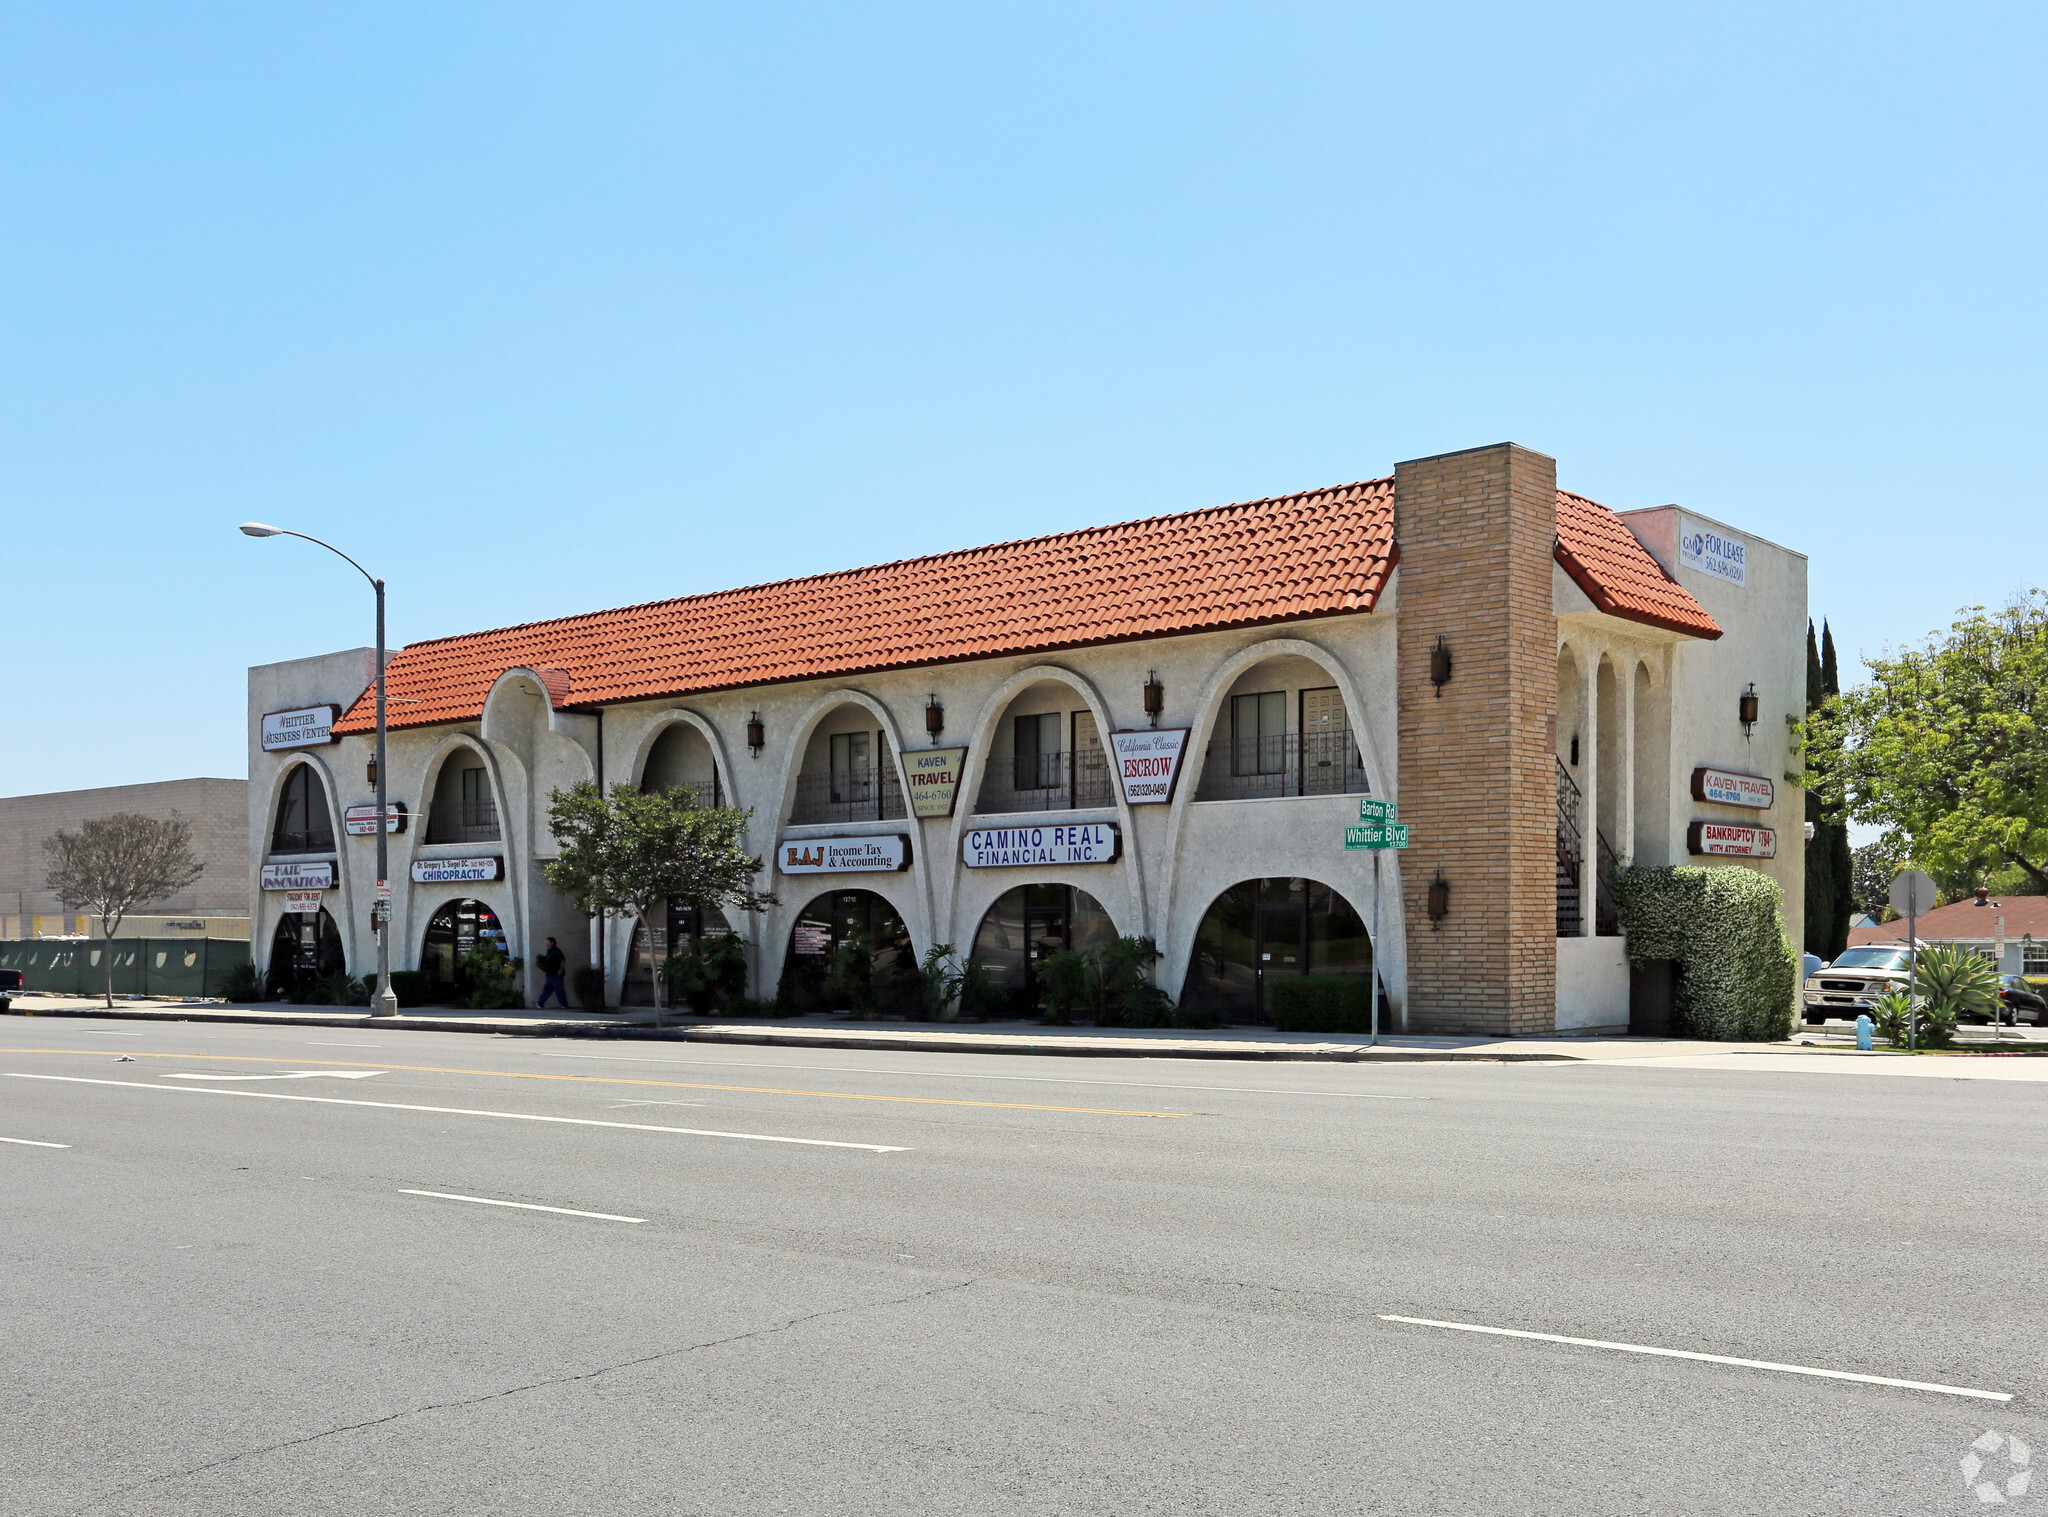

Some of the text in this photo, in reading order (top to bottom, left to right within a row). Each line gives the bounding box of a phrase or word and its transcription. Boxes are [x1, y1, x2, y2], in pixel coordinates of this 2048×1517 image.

[1705, 533, 1744, 565] FOR LEASE
[279, 713, 315, 729] WHITTIER
[1117, 735, 1179, 757] California Classic
[917, 756, 947, 768] KAVEN
[1123, 756, 1173, 778] ESCROW
[910, 771, 955, 787] TRAVEL
[1706, 775, 1771, 796] KAVEN TRAVEL
[913, 789, 952, 801] 464-6760
[1708, 788, 1741, 802] 464-6760
[1361, 800, 1395, 819] Barton Rd
[972, 825, 1104, 850] CAMINO REAL
[1347, 826, 1407, 843] Whittier Blvd
[1706, 826, 1756, 843] BANKRUPTCY
[787, 843, 882, 867] E.A.J Income Tax
[977, 846, 1098, 865] FINANCIAL INC.
[1709, 844, 1723, 853] WITH
[1724, 845, 1753, 855] ATTORNEY
[423, 861, 441, 870] Gregory
[442, 860, 447, 868] S.
[447, 860, 461, 869] Siegel
[828, 855, 892, 868] & Accounting
[274, 864, 302, 876] HAIR
[422, 868, 485, 881] CHIROPRACTIC
[263, 875, 331, 889] INNOVATIONS
[303, 892, 311, 901] FOR
